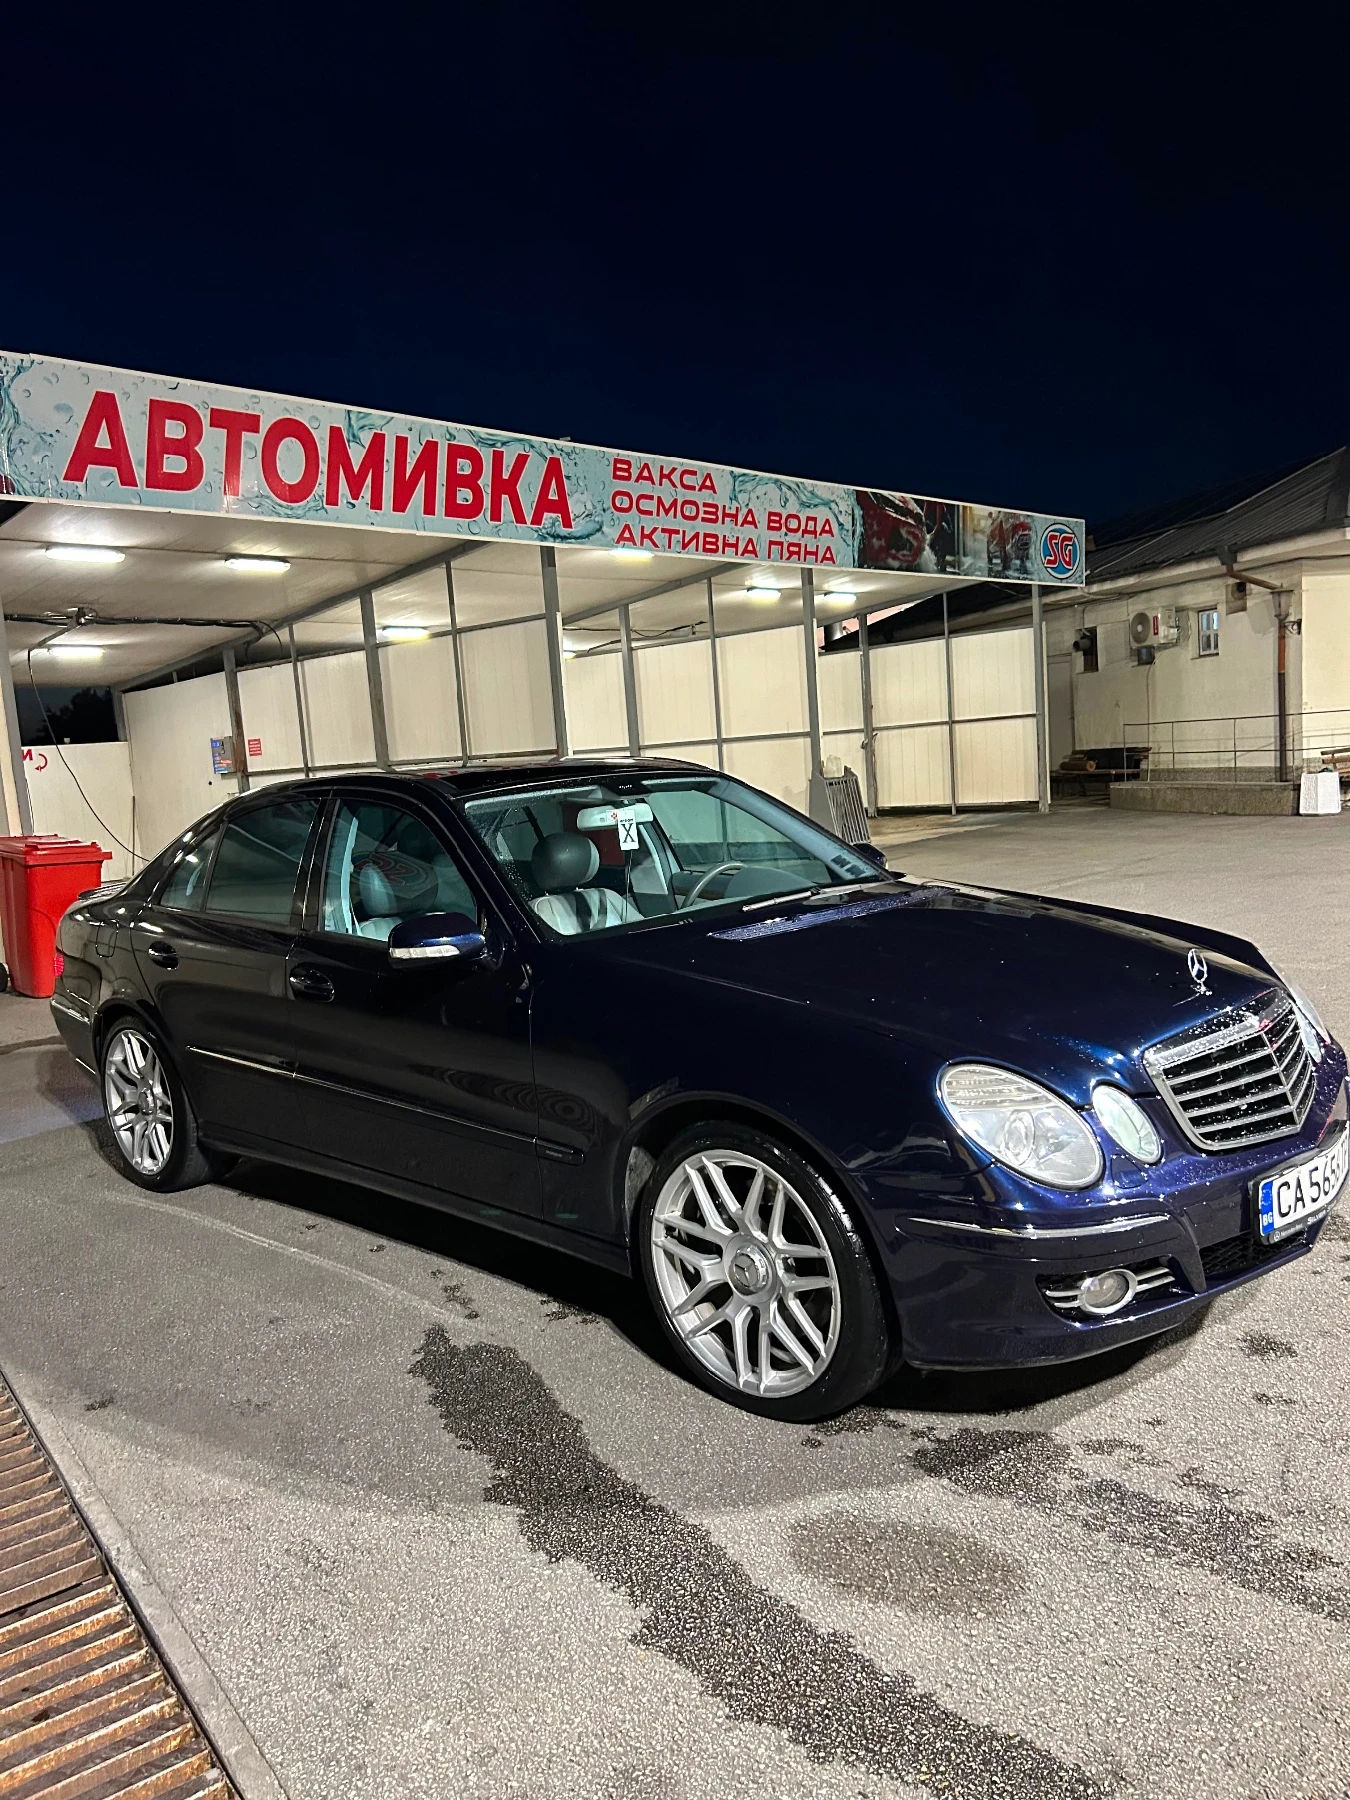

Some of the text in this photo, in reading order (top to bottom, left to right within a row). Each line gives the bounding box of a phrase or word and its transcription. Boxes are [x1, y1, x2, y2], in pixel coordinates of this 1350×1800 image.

[62, 390, 574, 530] АВТОМИВКА
[611, 457, 717, 493] ВАКСА
[611, 489, 834, 538] ОСМОЗНА ВОДА
[616, 523, 836, 564] АКТИВНА ПЯНА
[1045, 531, 1075, 569] SG
[1262, 1211, 1273, 1227] BG
